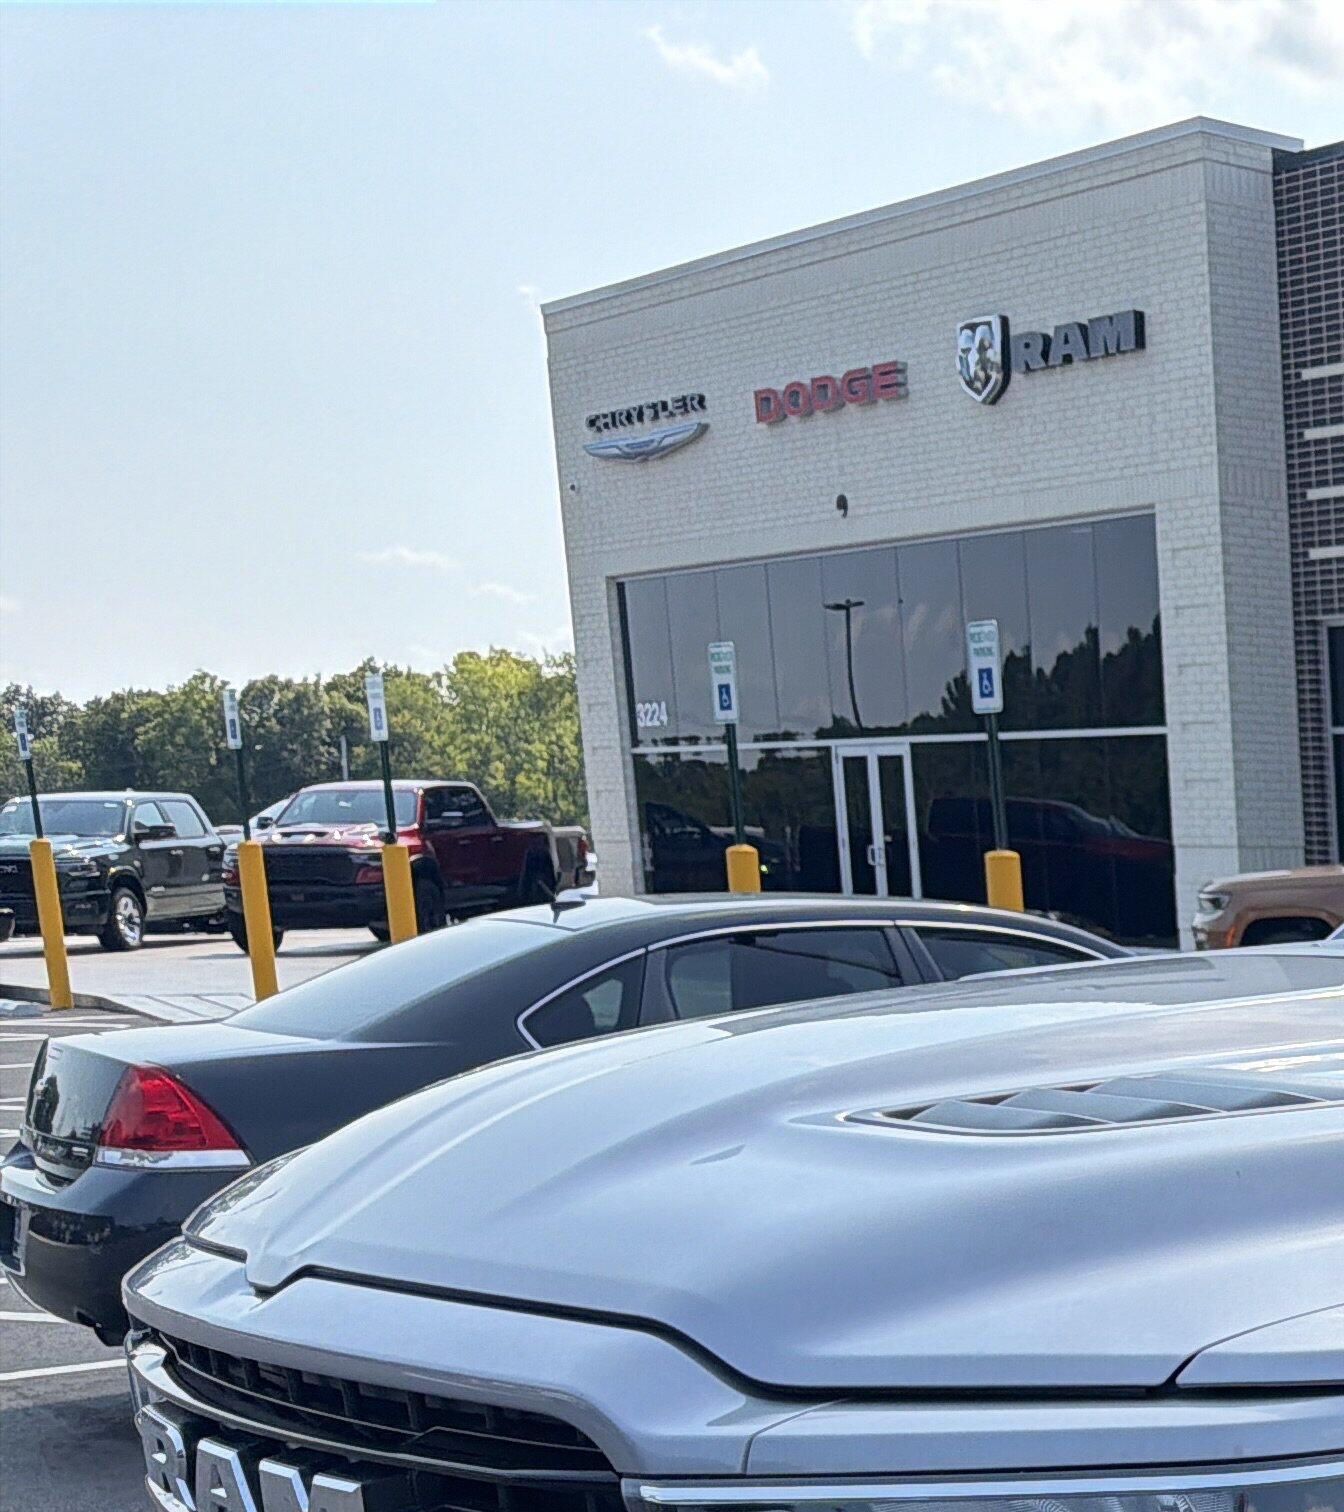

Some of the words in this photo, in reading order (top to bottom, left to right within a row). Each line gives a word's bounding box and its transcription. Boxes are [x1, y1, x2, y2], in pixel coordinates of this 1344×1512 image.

[1010, 309, 1146, 375] RAM
[584, 392, 707, 433] CHRYSLER
[753, 360, 908, 425] DODGE
[636, 700, 668, 728] 3224
